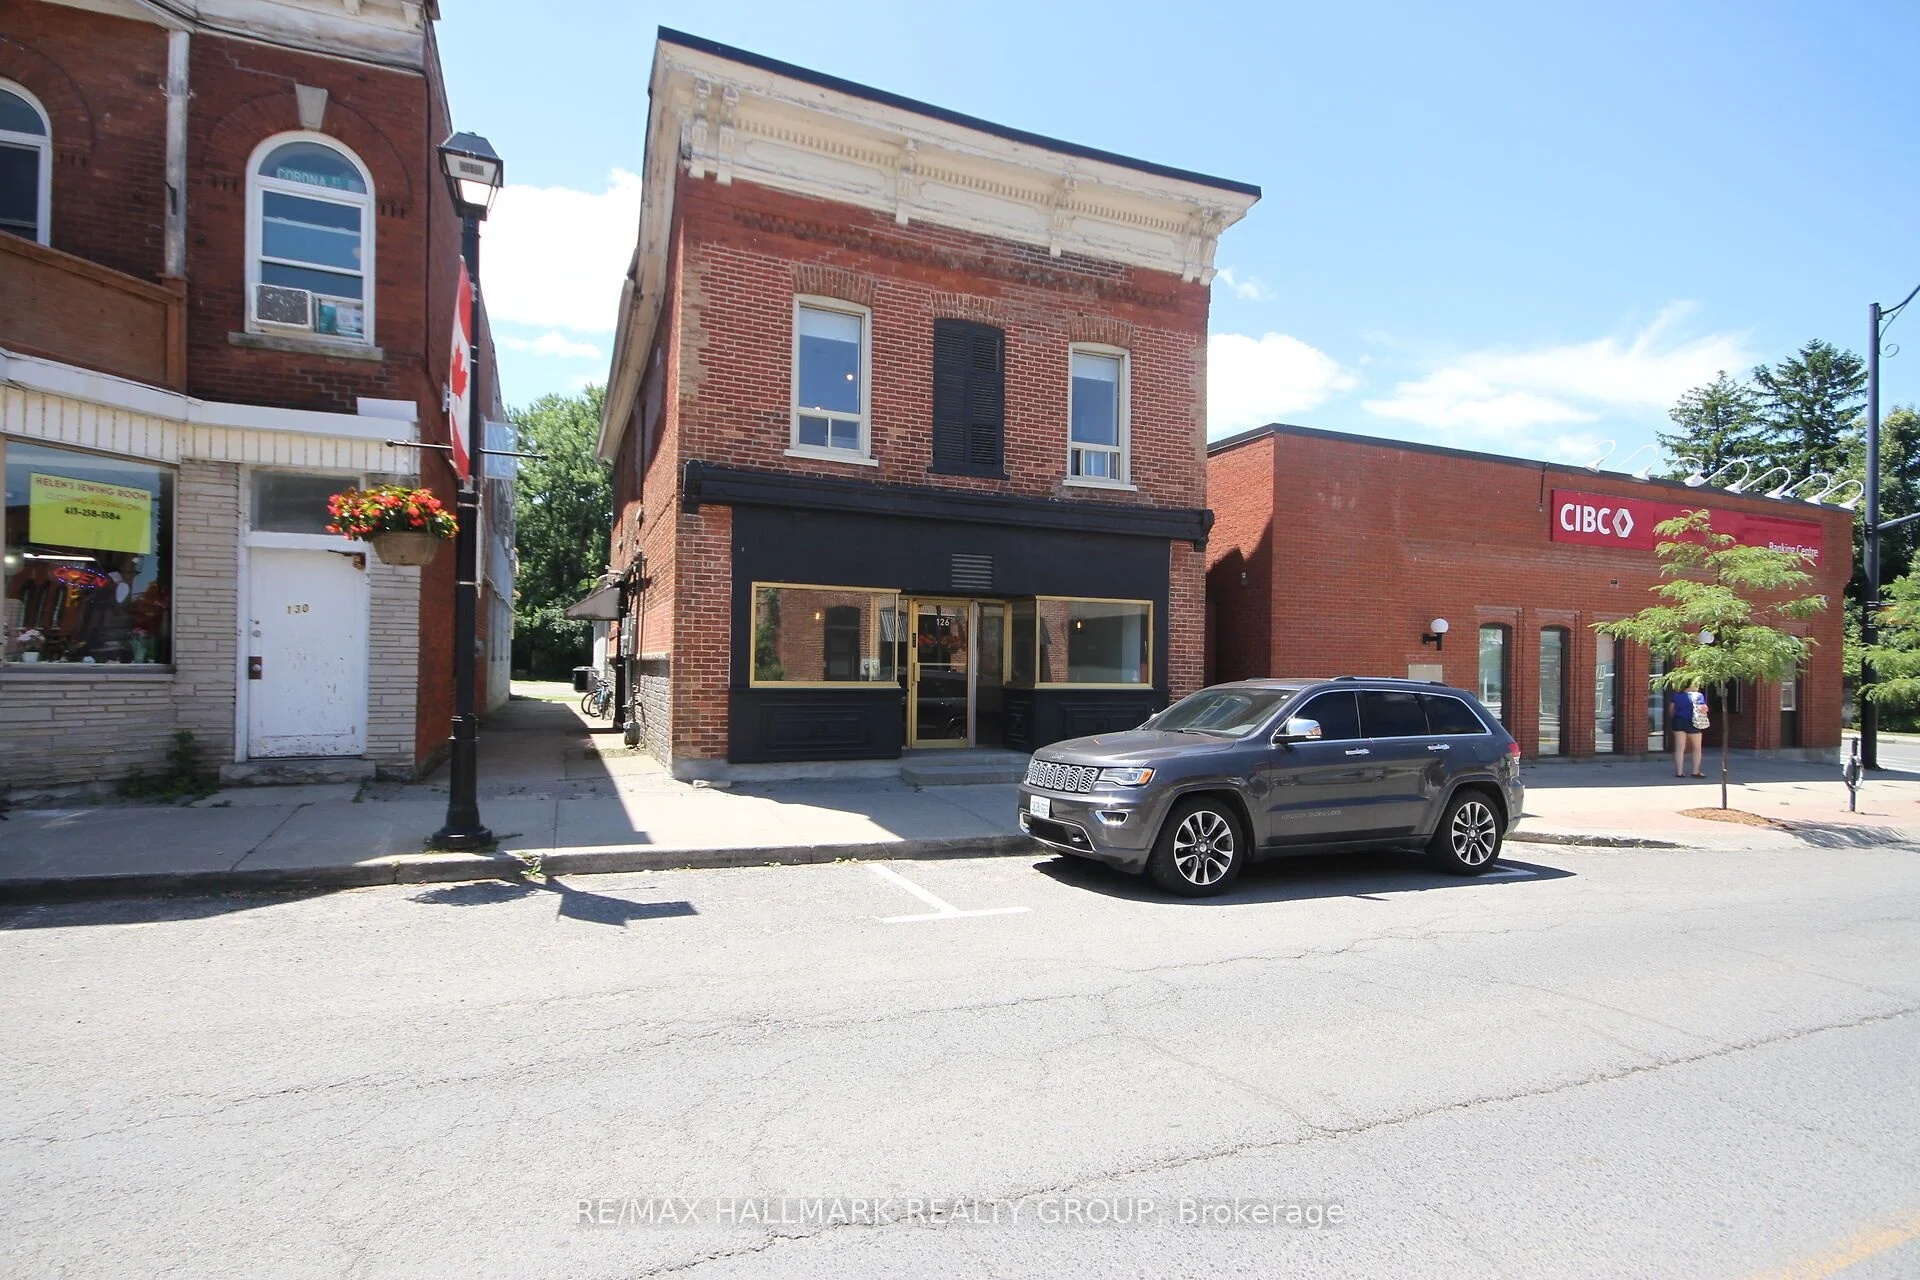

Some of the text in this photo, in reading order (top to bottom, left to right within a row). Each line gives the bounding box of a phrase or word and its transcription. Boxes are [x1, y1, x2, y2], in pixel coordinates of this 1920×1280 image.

[118, 488, 149, 501] ROOM
[1560, 503, 1611, 535] CIBC
[287, 603, 309, 615] 130
[936, 618, 950, 626] 126
